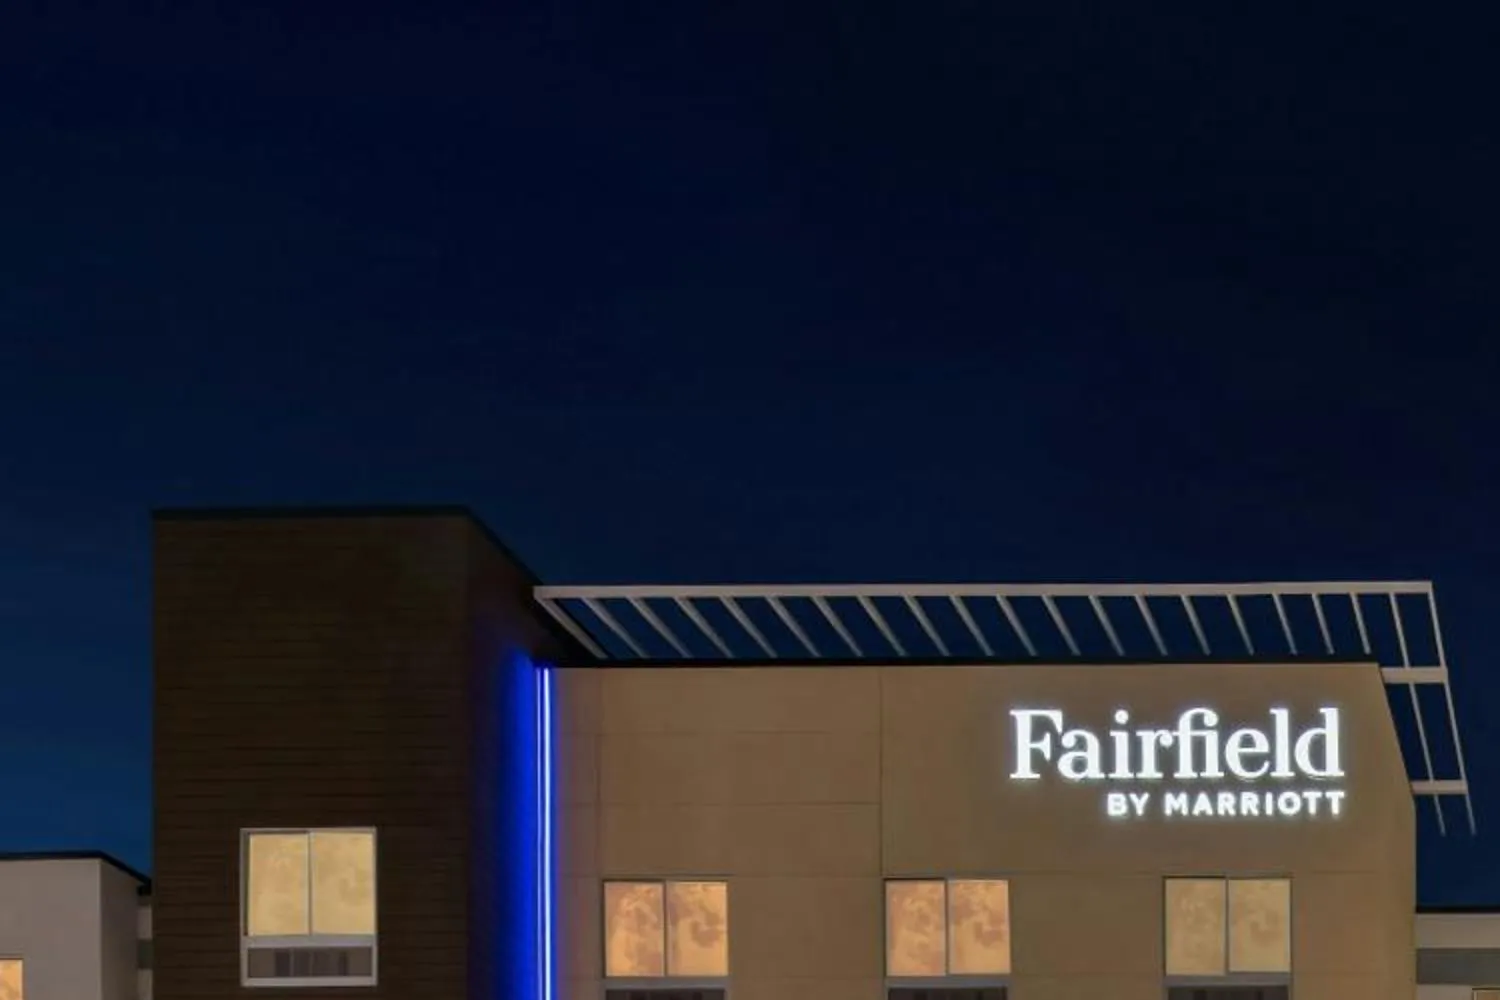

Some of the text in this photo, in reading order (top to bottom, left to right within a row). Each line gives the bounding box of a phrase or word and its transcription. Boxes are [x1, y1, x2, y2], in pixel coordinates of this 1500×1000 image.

[1009, 707, 1345, 781] Fairfield
[1107, 790, 1345, 817] BY MARRIOTT
